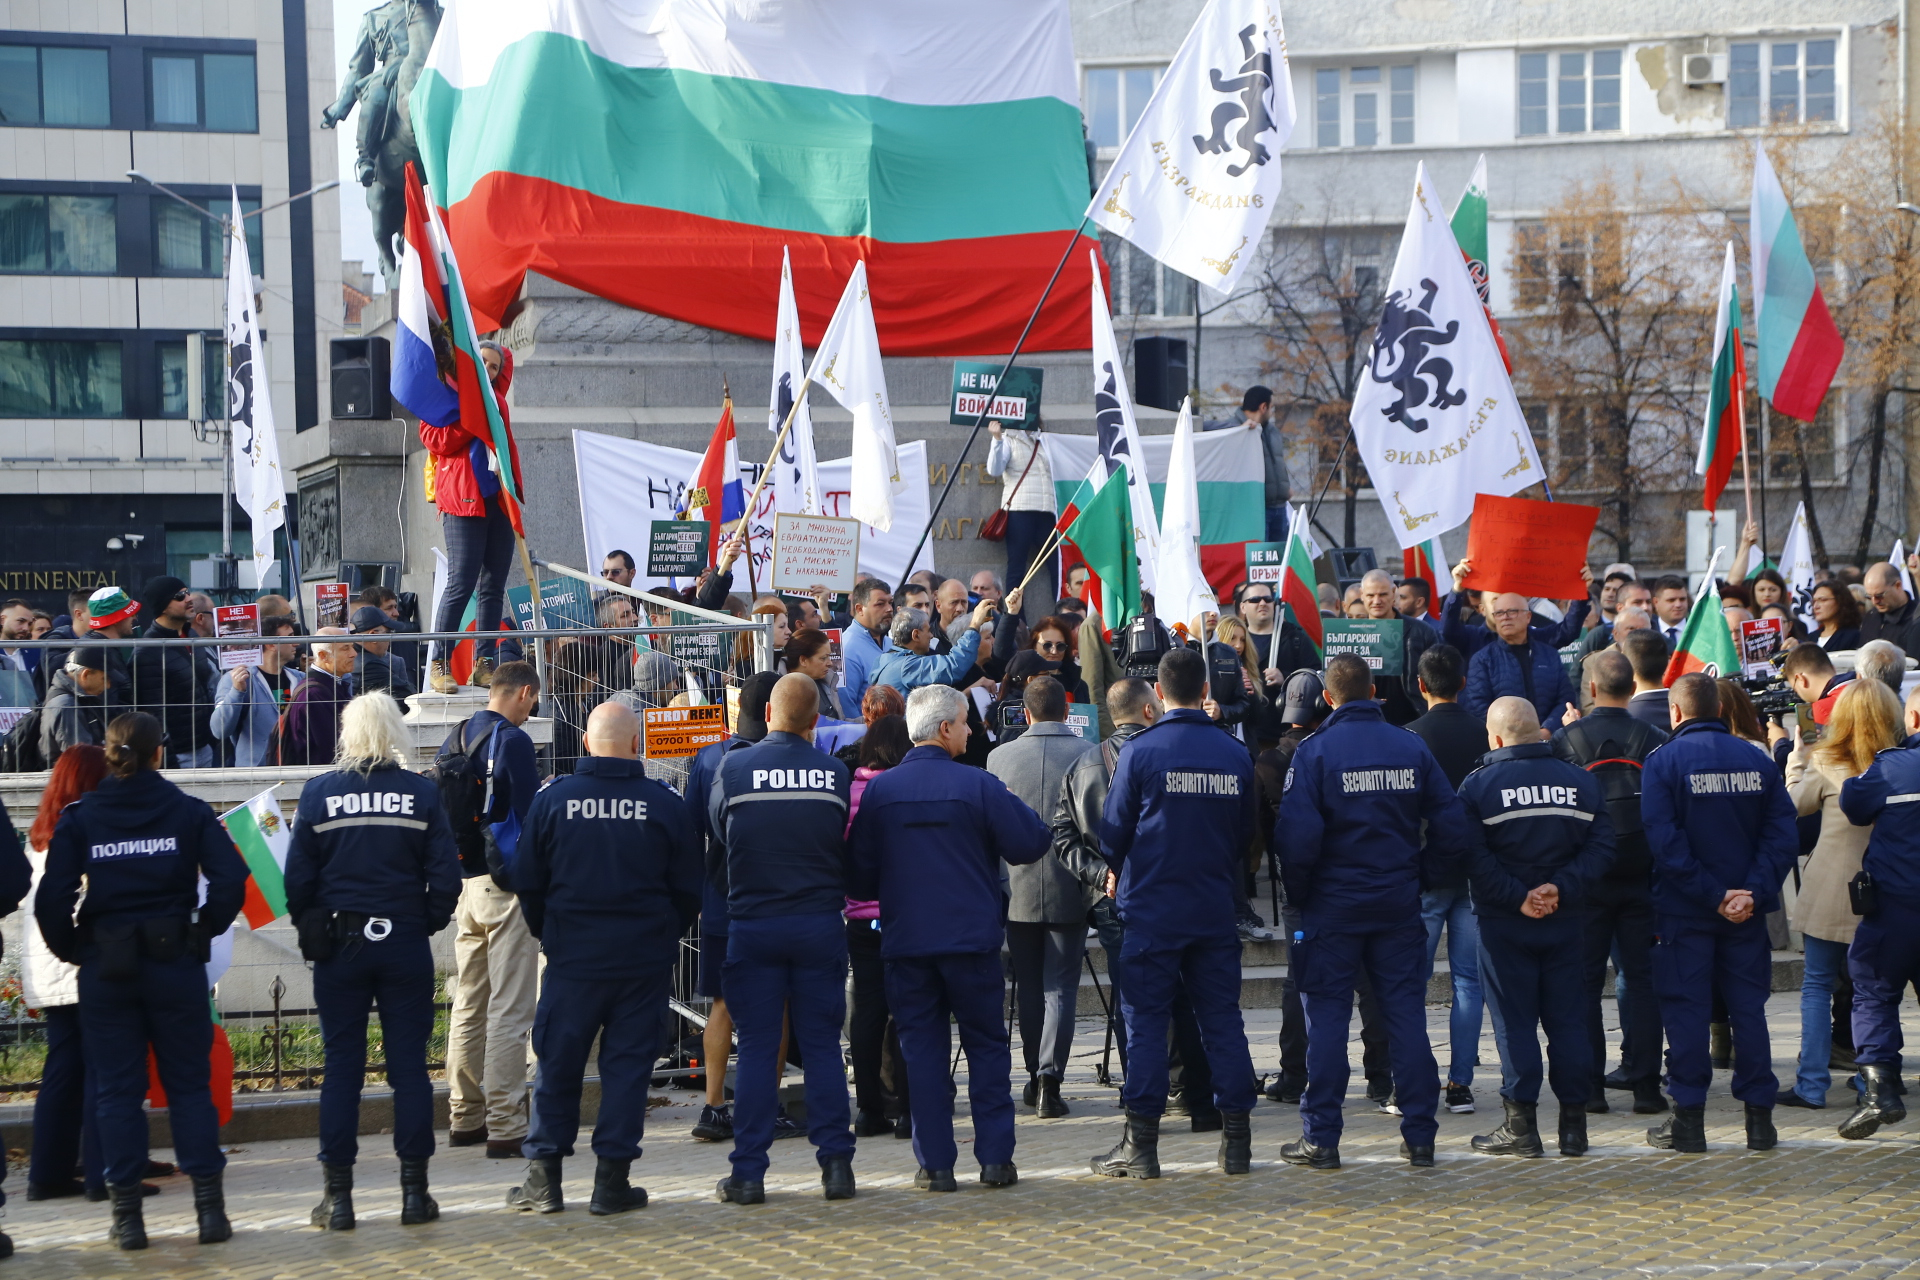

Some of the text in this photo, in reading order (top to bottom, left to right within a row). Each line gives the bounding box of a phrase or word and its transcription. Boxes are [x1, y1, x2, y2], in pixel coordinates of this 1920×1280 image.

[961, 372, 997, 390] НЕ НА
[790, 522, 846, 535] ЗА МНОЗИНА
[654, 532, 678, 541] БЪЛГАРИЯ
[781, 533, 854, 546] ЕВРОАТЛАНТИЦИ
[804, 556, 838, 565] МИСЛЯТ
[1251, 550, 1278, 562] НЕ НА
[796, 568, 838, 577] НАКАЗАНИЕ
[1252, 568, 1279, 580] ОРЪЖ
[518, 592, 576, 614] ОКУАТОРИТЕ
[230, 607, 244, 615] НЕ!
[1755, 620, 1769, 629] НЕ!
[1326, 633, 1381, 643] БЪЛГАРСКИЯТ
[1326, 646, 1370, 656] НАРОД Е ЗА
[647, 708, 720, 723] STROYRENT
[656, 737, 683, 745] 0700
[692, 735, 720, 743] 9988
[752, 768, 835, 790] POLICE
[1166, 772, 1239, 795] SECURITY POLICE
[1342, 768, 1415, 793] SECURITY POLICE
[1690, 772, 1762, 794] SECURITY POLICE
[1500, 786, 1577, 807] POLICE
[326, 792, 415, 817] POLICE
[566, 798, 648, 820] POLICE
[92, 837, 176, 860] ПОЛИЦИЯ
